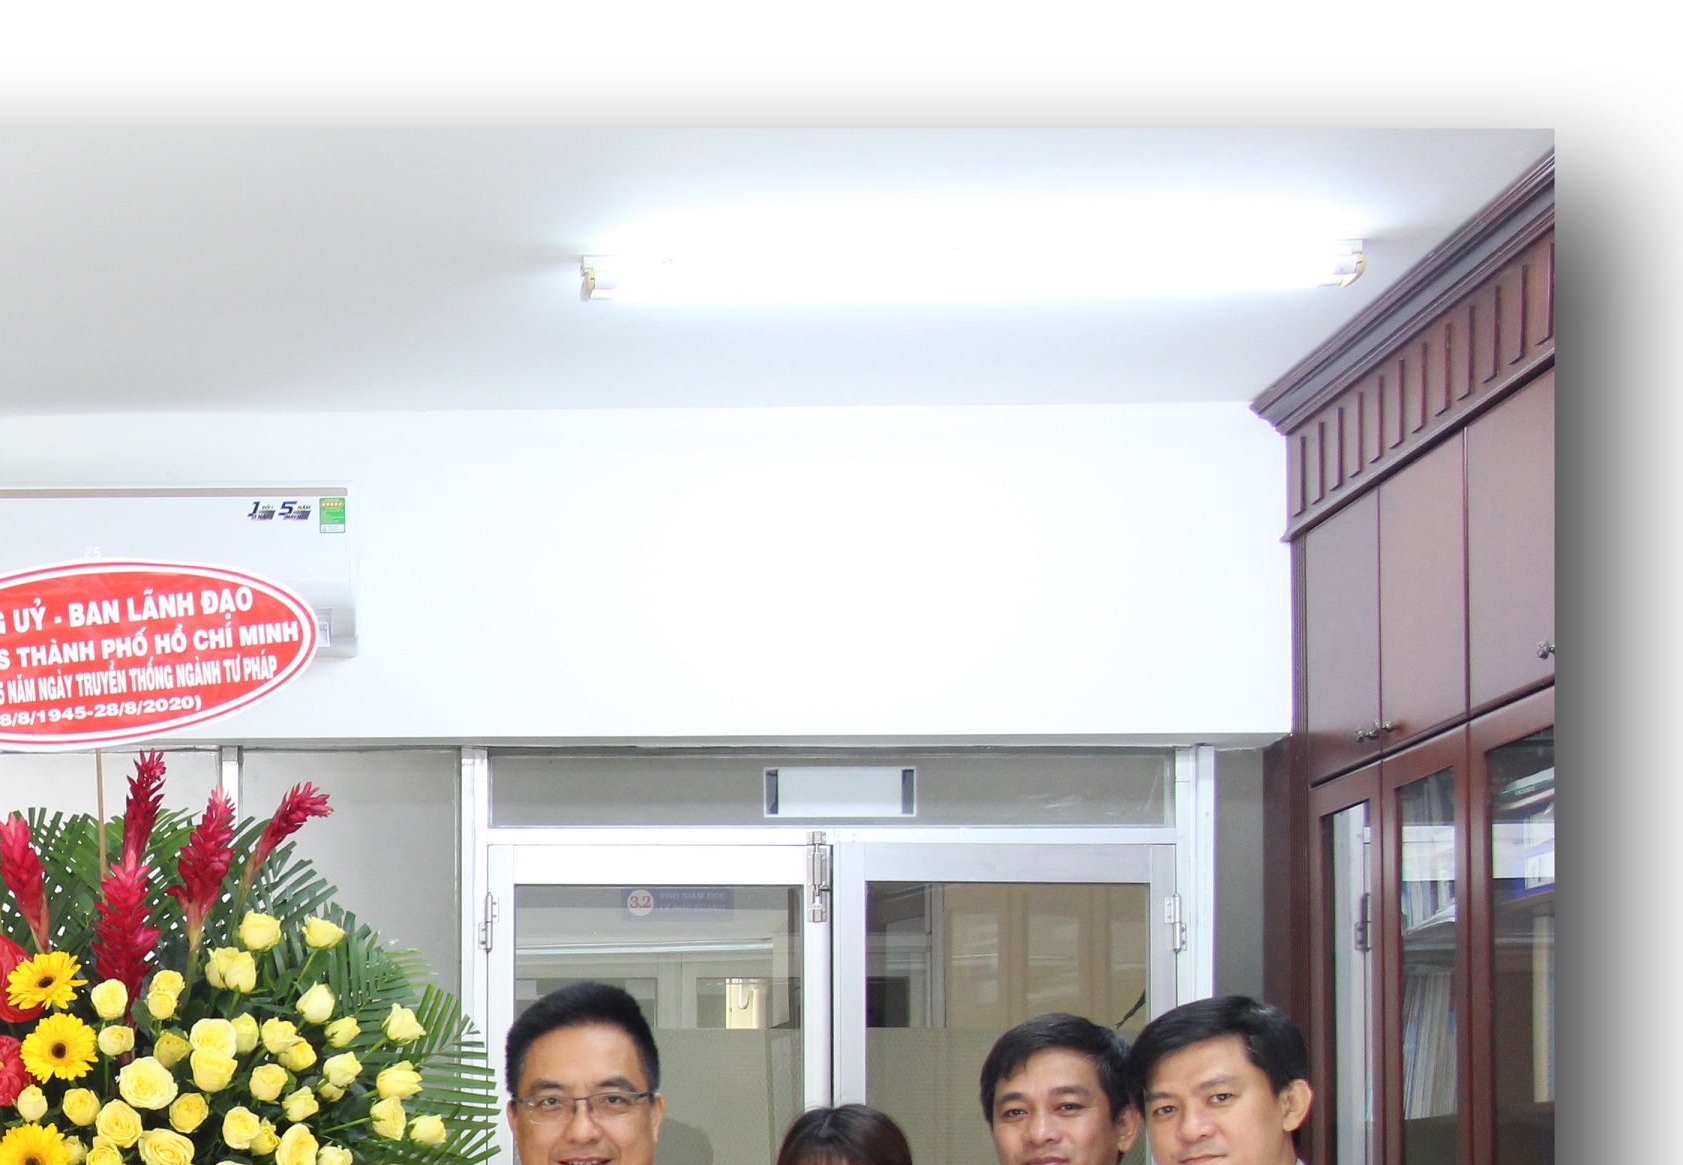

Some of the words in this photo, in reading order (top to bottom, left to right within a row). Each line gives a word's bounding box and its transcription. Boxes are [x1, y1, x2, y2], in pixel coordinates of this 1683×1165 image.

[13, 598, 46, 633] UỶ
[68, 599, 120, 627] BAN
[126, 589, 195, 622] LÃNH
[201, 586, 254, 620] ĐẠO
[16, 639, 95, 668] THÀNH
[101, 626, 148, 659] PHỐ
[154, 623, 187, 654] HỒ
[193, 621, 233, 651] CHÍ
[238, 621, 299, 646] MINH
[7, 673, 37, 704] NĂM
[38, 670, 73, 701] NGÀY
[75, 660, 127, 697] TRUYỀN
[129, 656, 174, 691] THỐNG
[175, 656, 221, 687] NGÀNH
[222, 653, 241, 683] TƯ
[243, 649, 278, 681] PHÁP
[629, 895, 652, 909] 3.2
